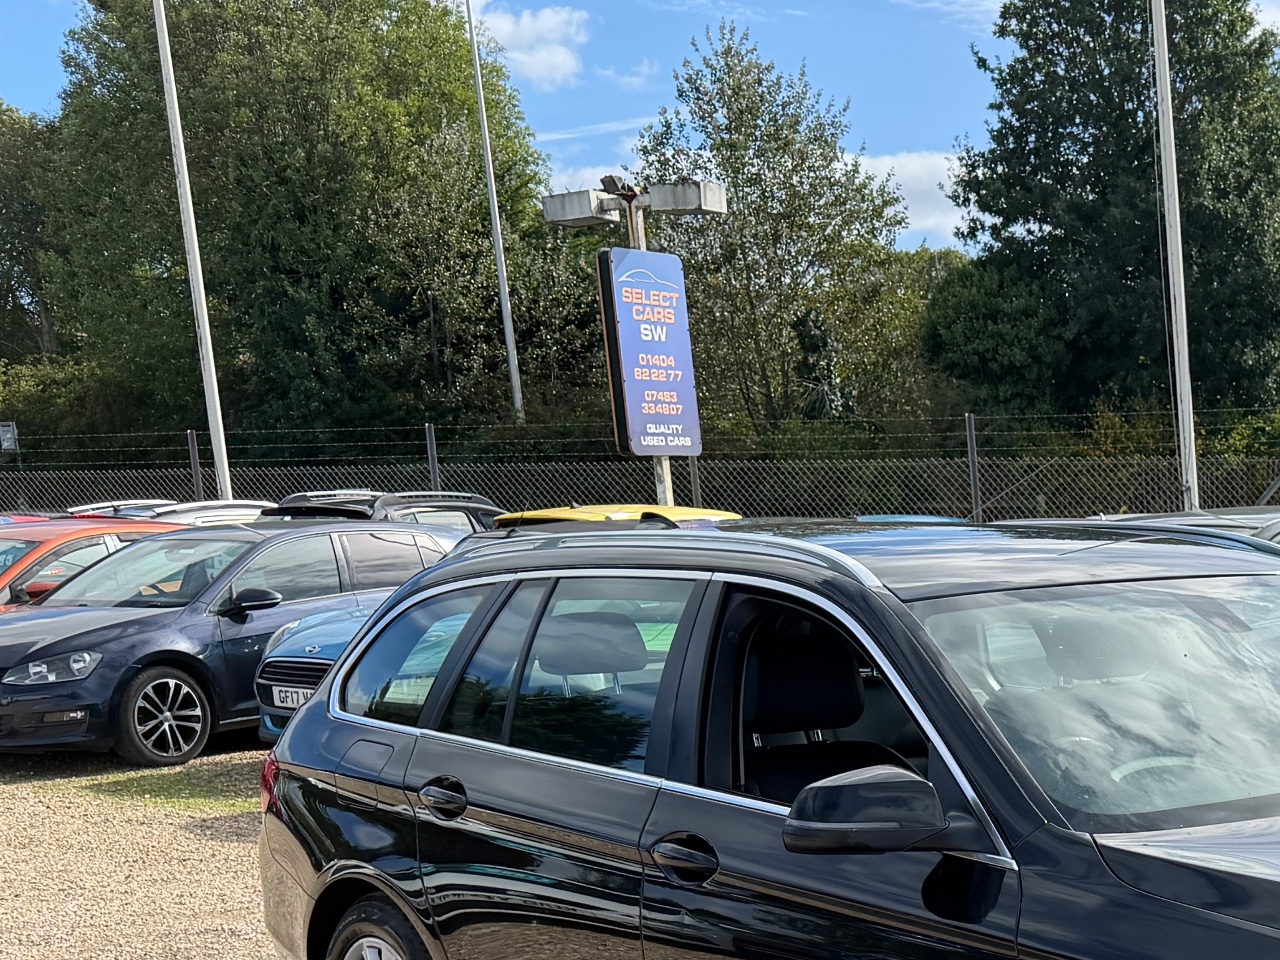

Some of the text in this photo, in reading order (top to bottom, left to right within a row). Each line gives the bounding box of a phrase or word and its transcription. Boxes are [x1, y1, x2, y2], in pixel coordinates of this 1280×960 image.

[621, 287, 679, 308] SELECT
[632, 306, 675, 324] CARS
[640, 324, 667, 342] SW
[638, 353, 675, 368] 01404
[644, 390, 678, 402] 07483
[641, 402, 683, 415] 334807
[646, 423, 683, 434] QUALITY
[641, 435, 692, 446] USED CARS
[278, 689, 300, 705] GF17
